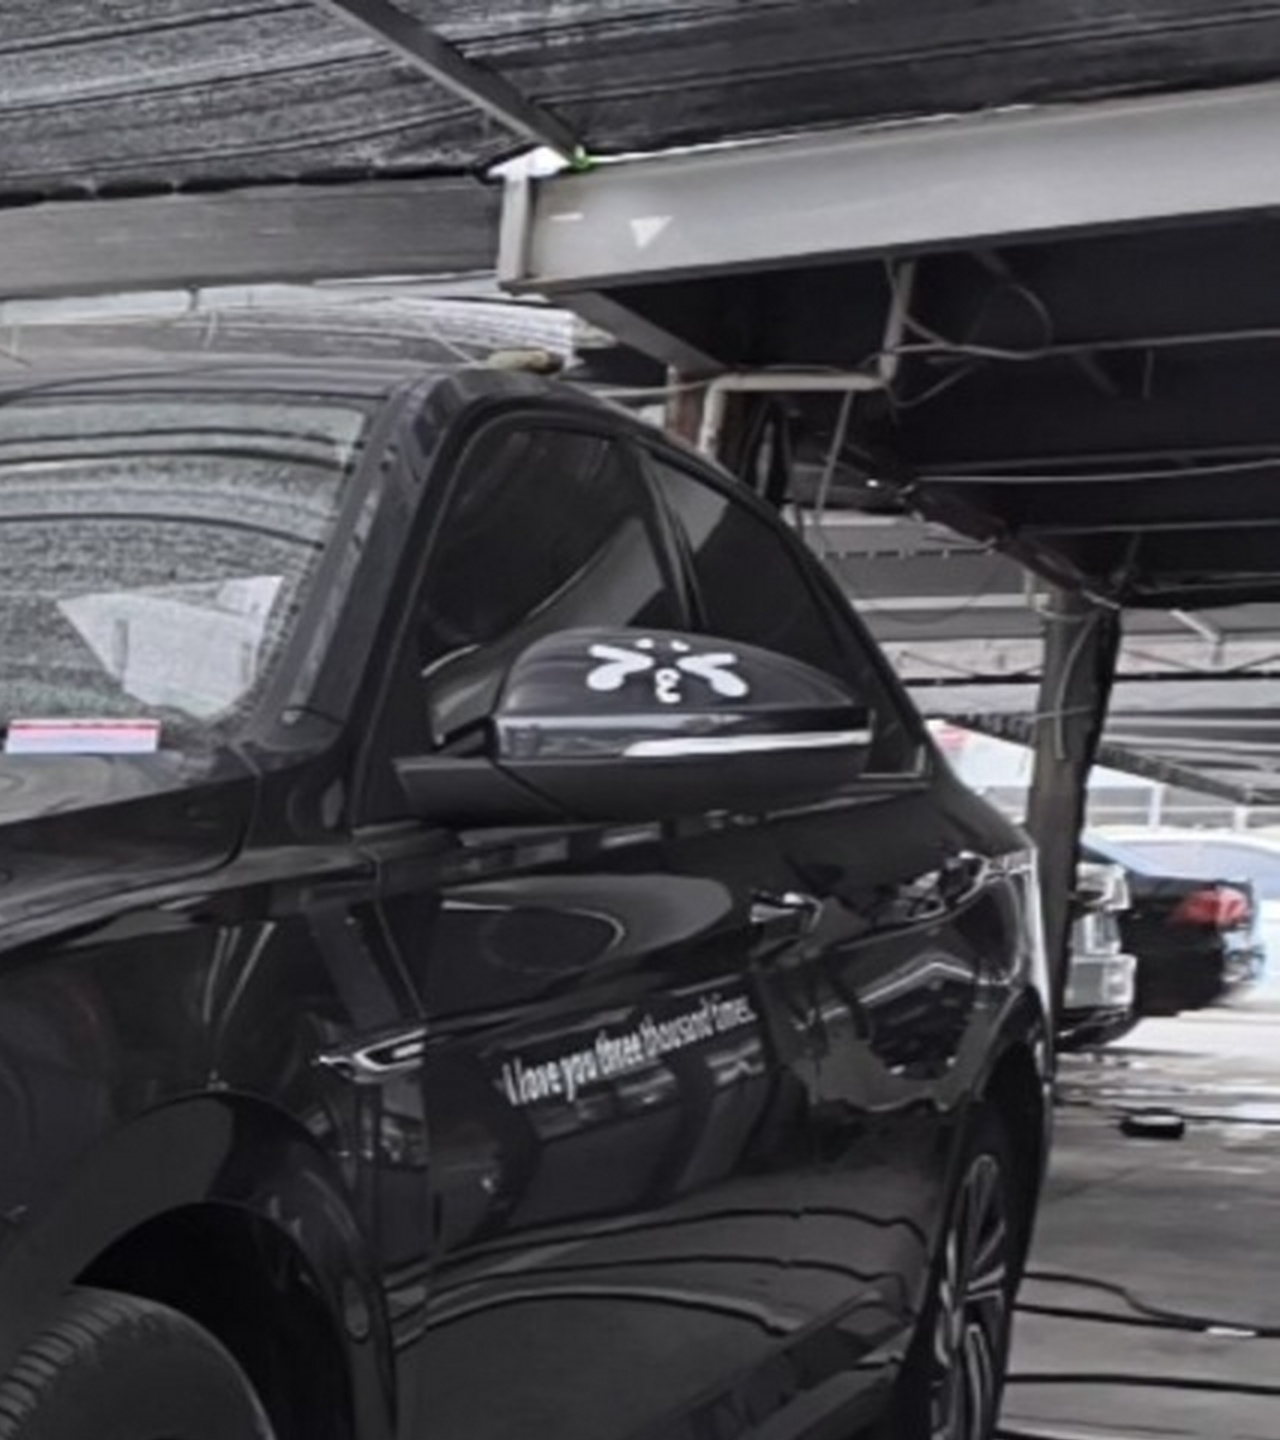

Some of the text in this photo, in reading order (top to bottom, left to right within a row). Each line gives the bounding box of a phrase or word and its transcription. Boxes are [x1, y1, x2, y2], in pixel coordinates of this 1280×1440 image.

[513, 1056, 562, 1105] love
[559, 1049, 598, 1101] you
[594, 1029, 644, 1075] three
[639, 996, 715, 1059] thousand
